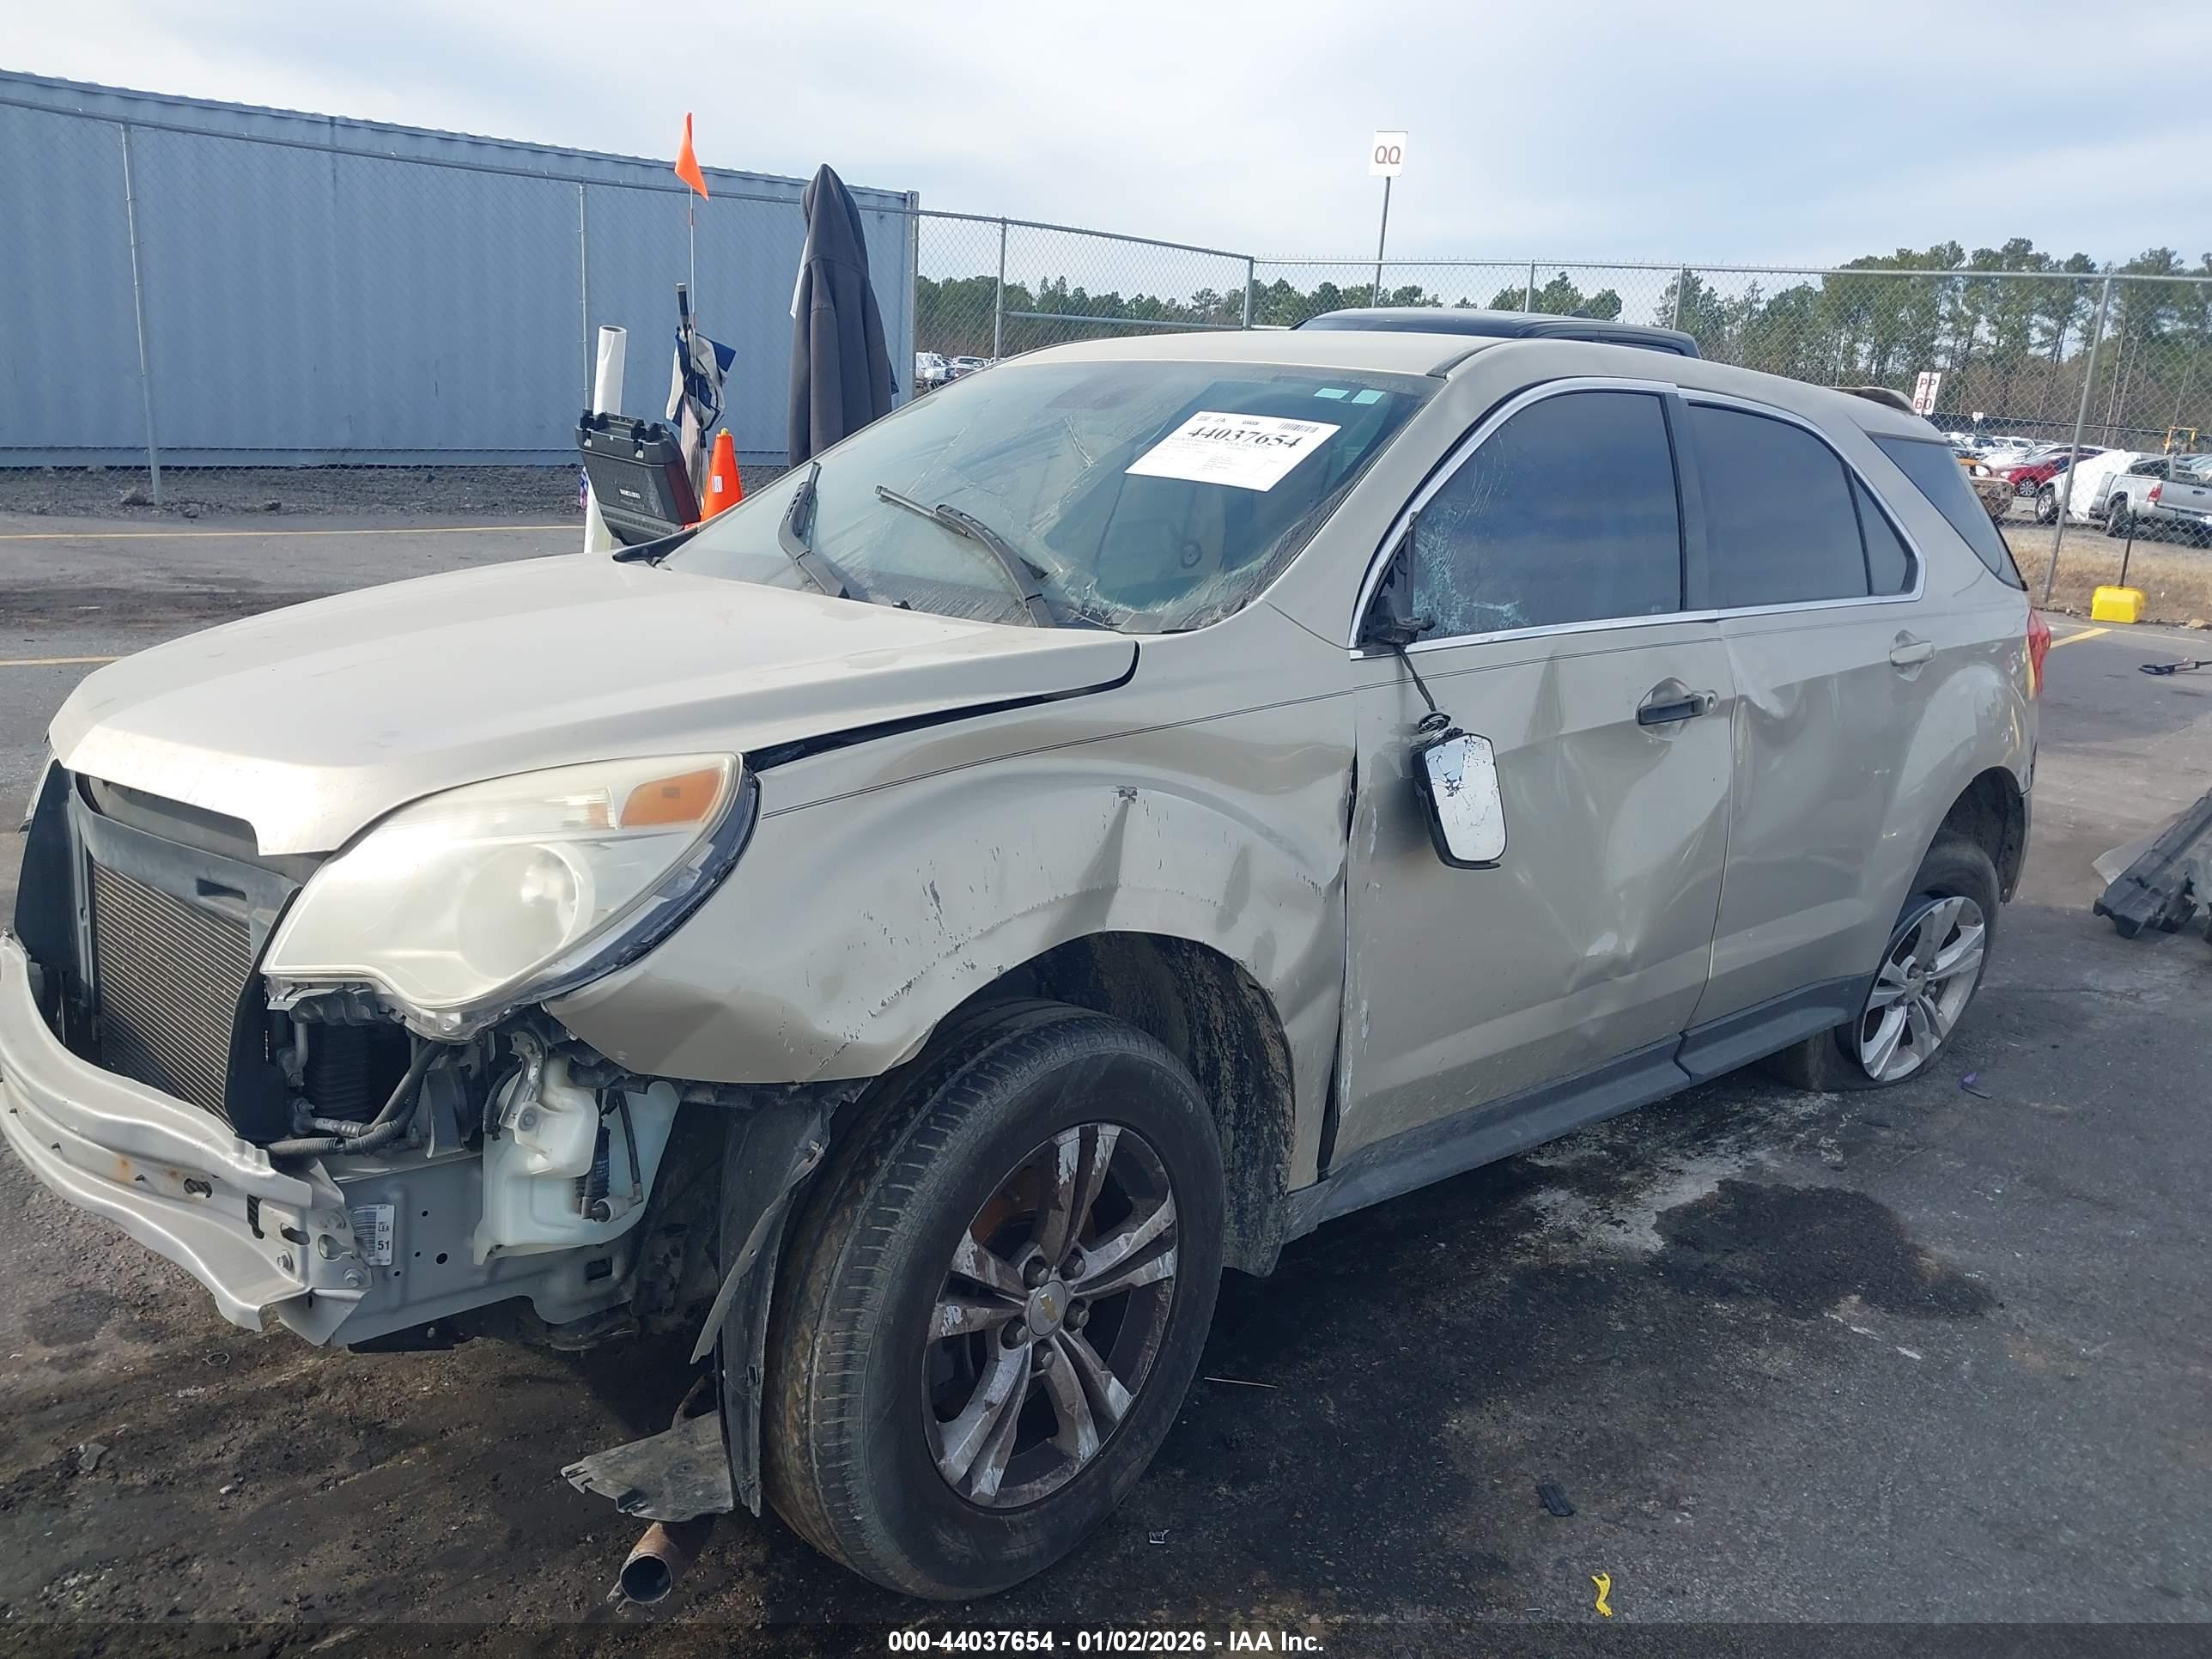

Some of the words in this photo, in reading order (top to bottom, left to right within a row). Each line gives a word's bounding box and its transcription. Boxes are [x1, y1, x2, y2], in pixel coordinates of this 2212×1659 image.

[1918, 378, 1937, 390] PP
[1914, 397, 1933, 410] 60
[1187, 426, 1304, 448] 44037654
[377, 1240, 390, 1251] 51
